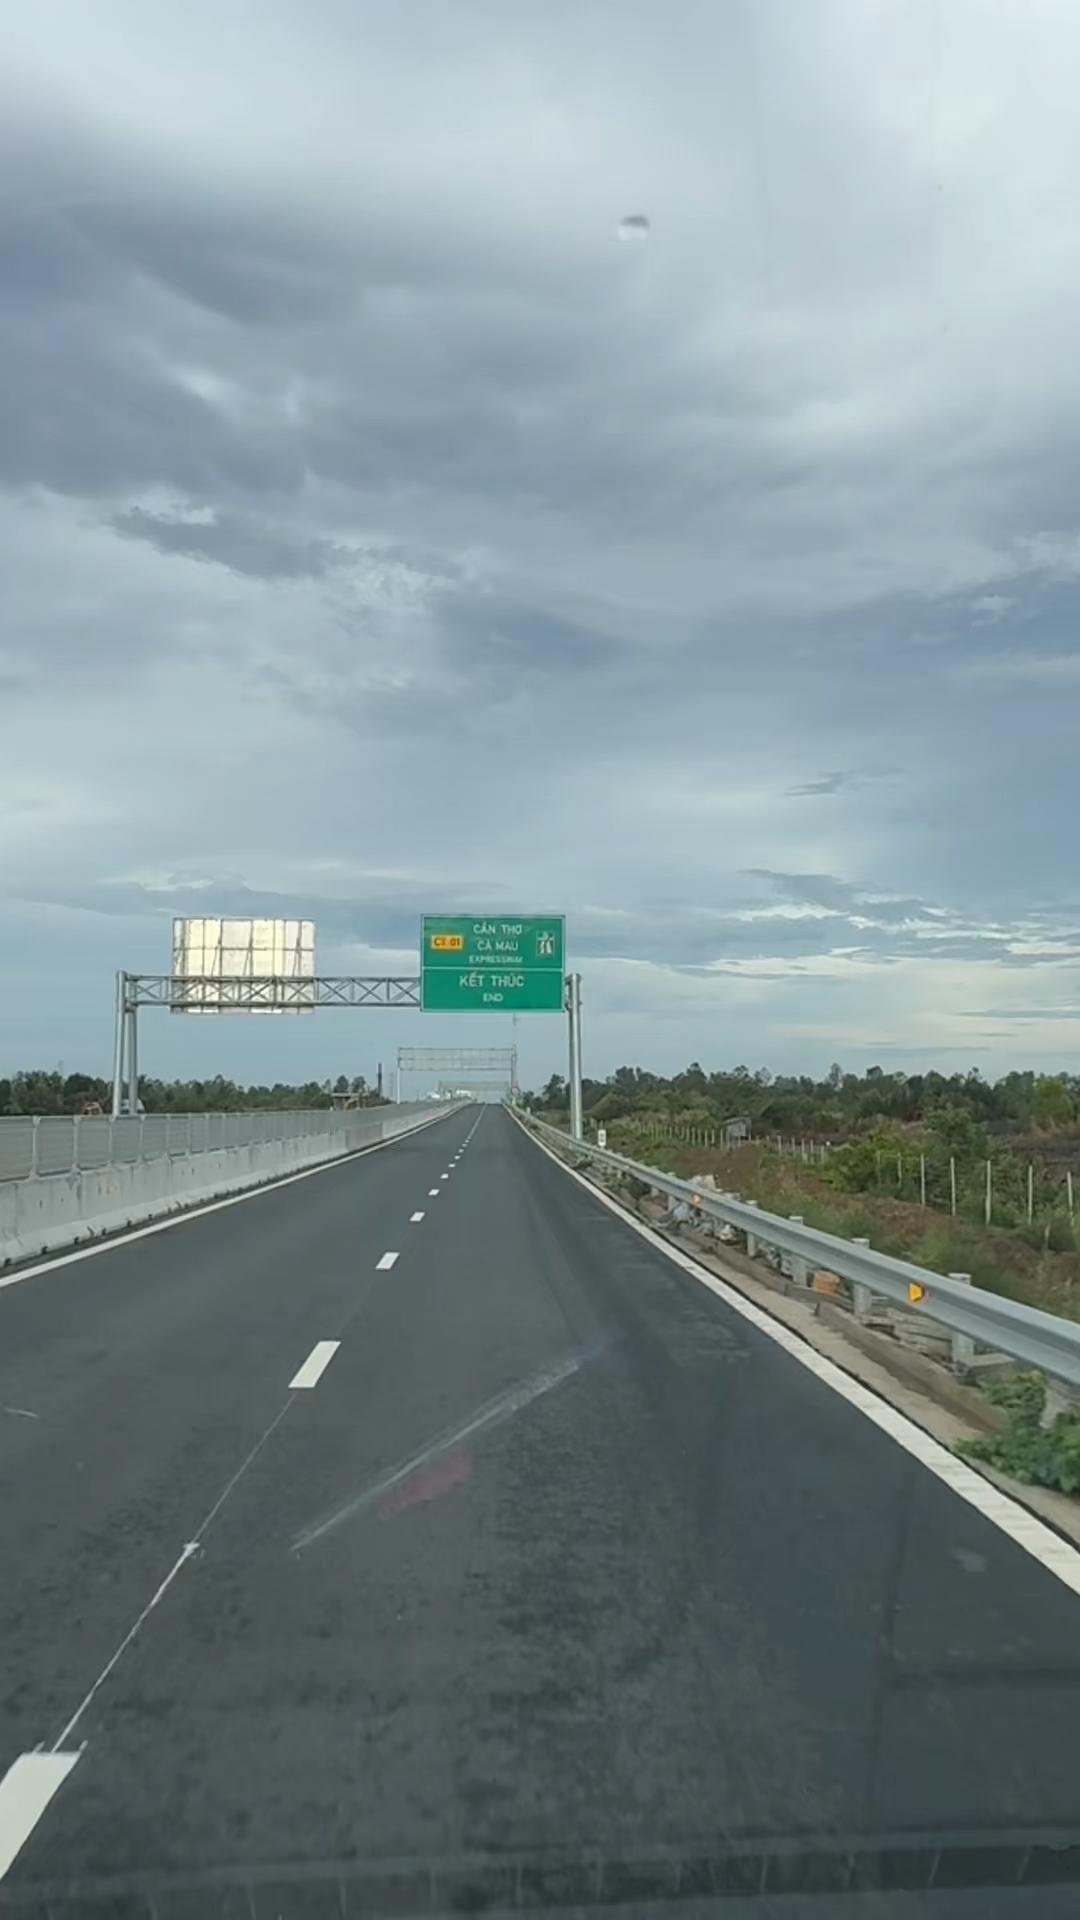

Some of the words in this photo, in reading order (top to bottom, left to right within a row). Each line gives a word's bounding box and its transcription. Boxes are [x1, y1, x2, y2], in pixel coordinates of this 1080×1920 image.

[500, 923, 523, 935] THƠ
[495, 941, 518, 951] MAU
[459, 971, 484, 987] KẾT
[491, 975, 525, 988] THÚC
[482, 993, 503, 1002] END
